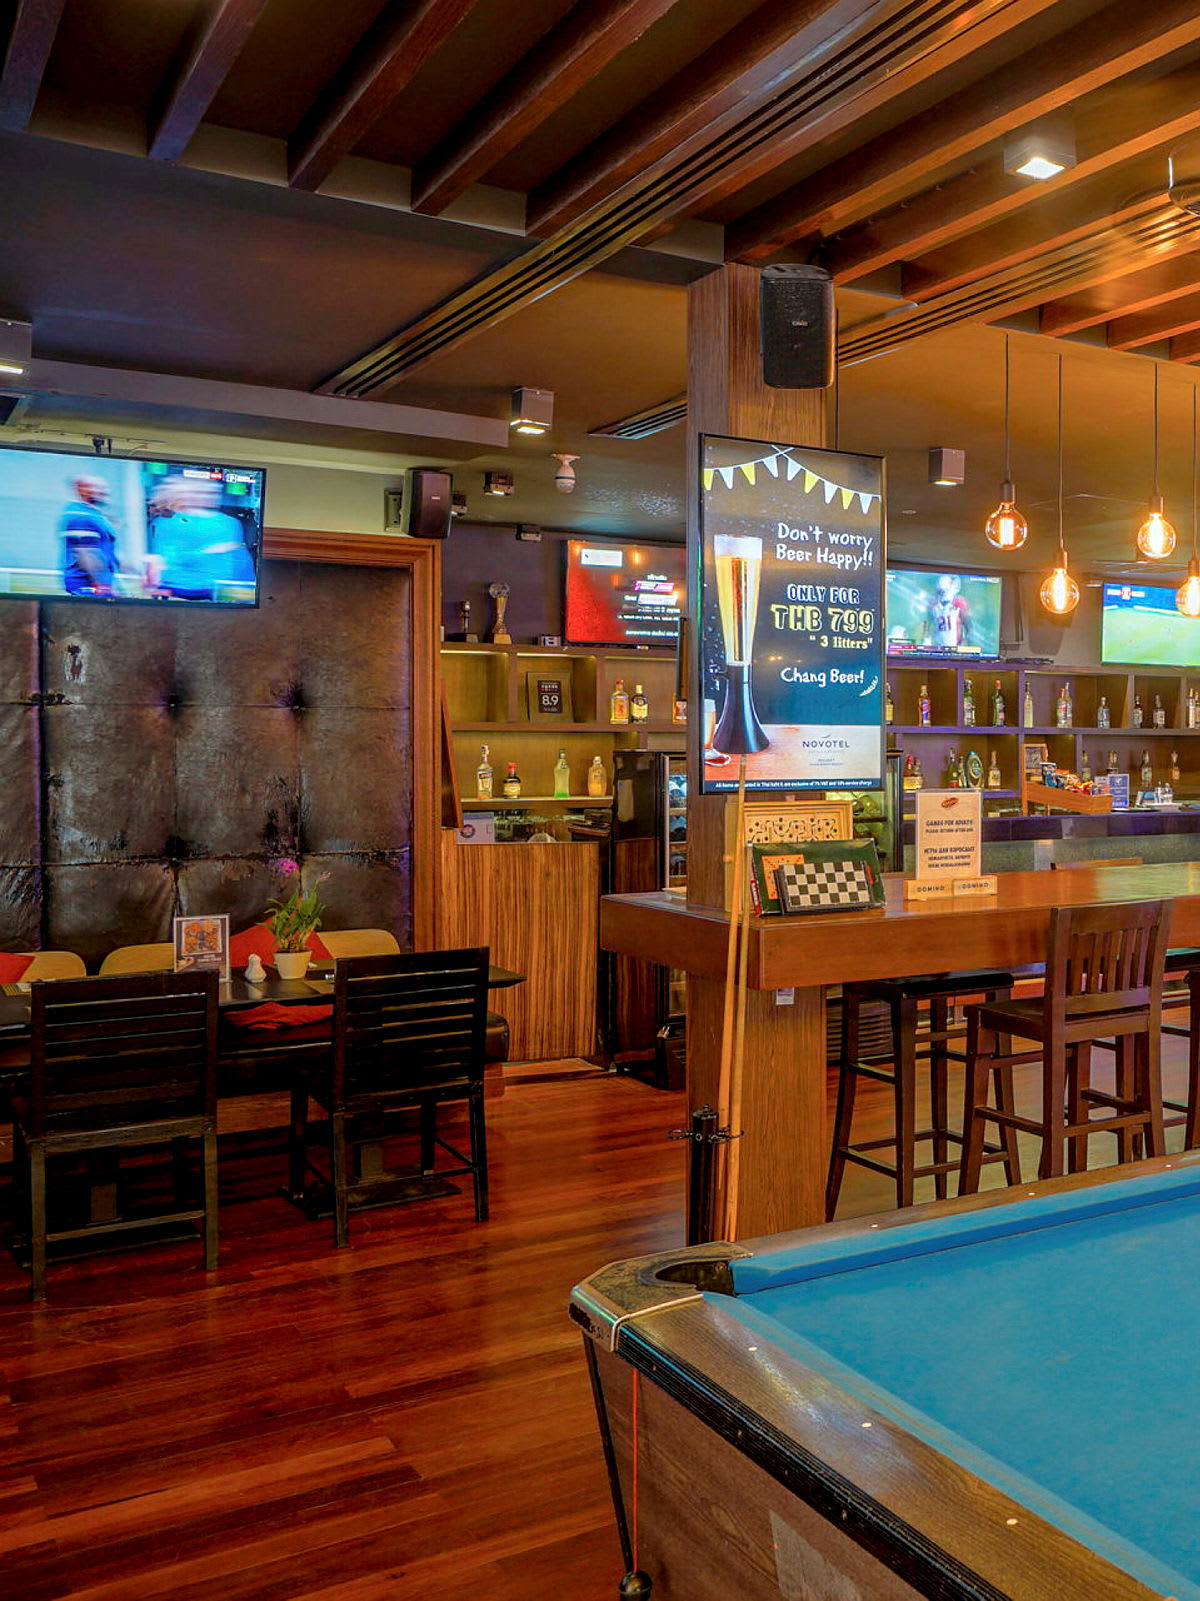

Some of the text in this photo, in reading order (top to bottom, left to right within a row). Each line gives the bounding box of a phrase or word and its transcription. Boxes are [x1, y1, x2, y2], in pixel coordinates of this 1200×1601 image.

[778, 522, 873, 551] Don't worry
[776, 543, 873, 571] Beer Happy!!
[787, 583, 860, 604] ONLY FOR
[770, 603, 874, 634] THB 799
[780, 667, 865, 688] Chang Beer!
[802, 740, 850, 748] NOVOTEL
[916, 885, 945, 893] DOMINO
